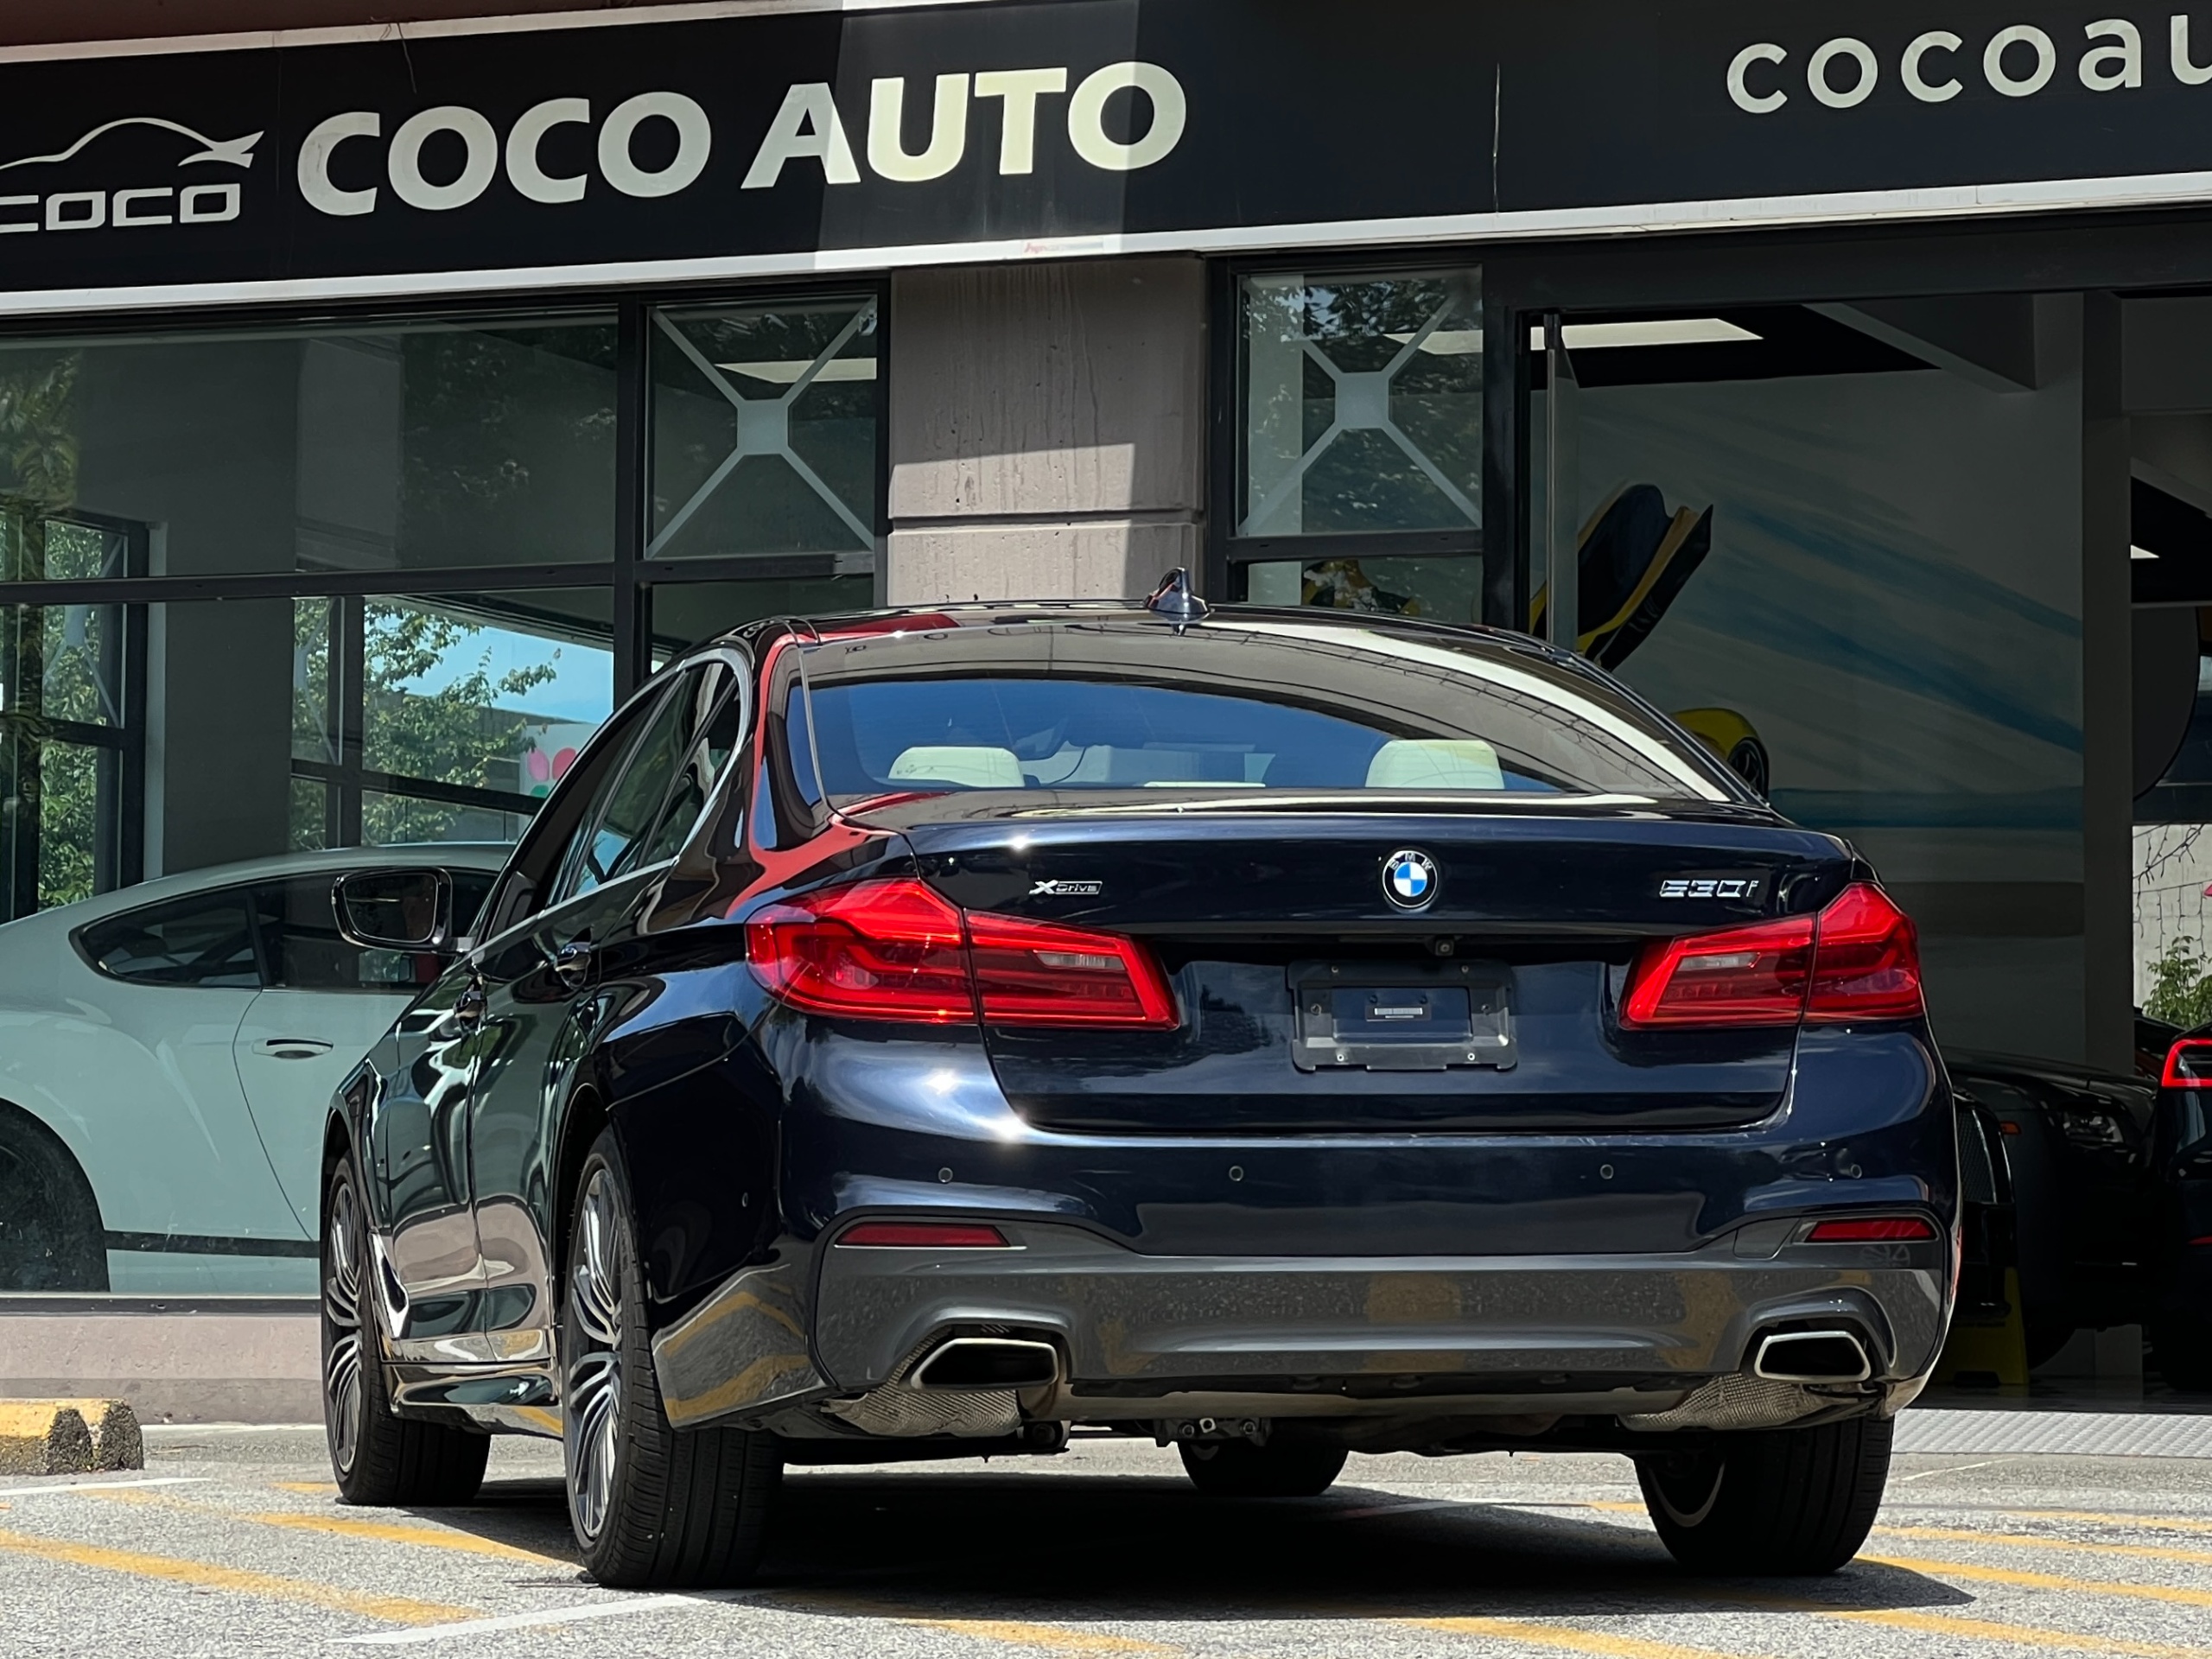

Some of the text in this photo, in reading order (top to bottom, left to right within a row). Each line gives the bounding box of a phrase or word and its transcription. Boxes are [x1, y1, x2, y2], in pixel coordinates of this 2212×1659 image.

[296, 61, 1187, 216] COCO AUTO
[1388, 852, 1433, 871] BMW
